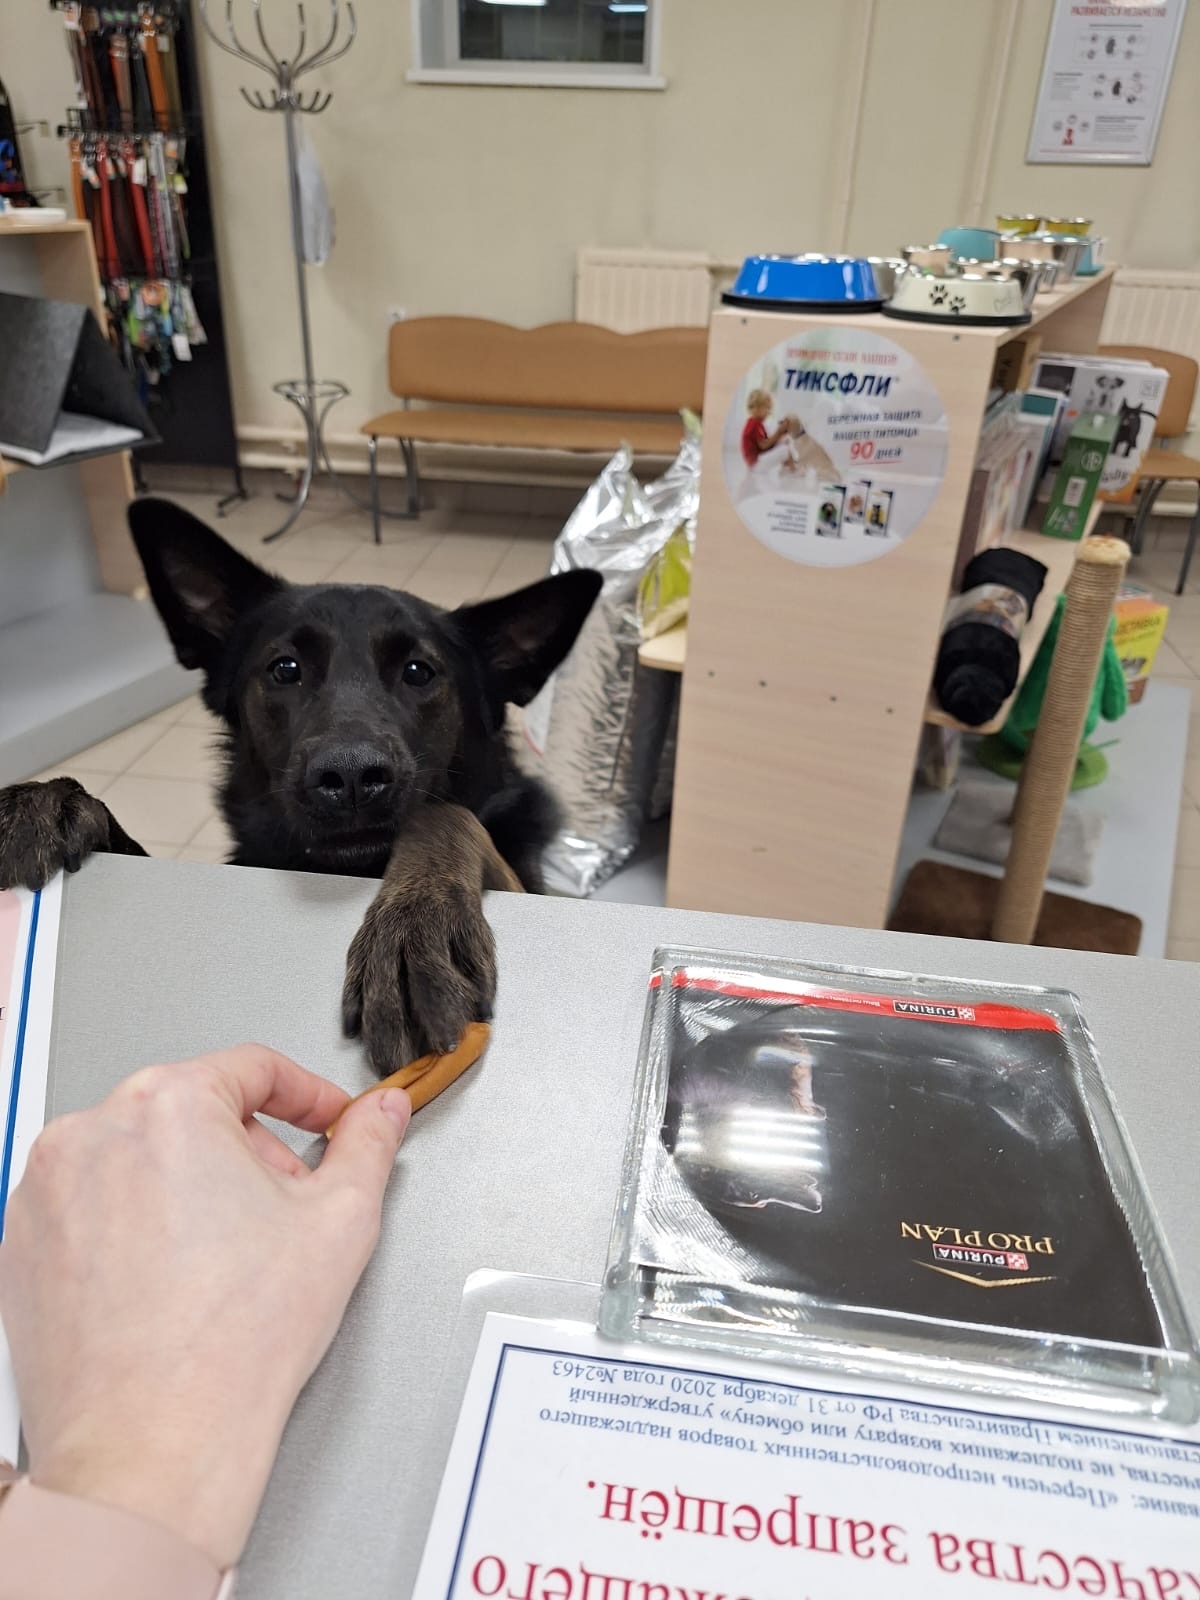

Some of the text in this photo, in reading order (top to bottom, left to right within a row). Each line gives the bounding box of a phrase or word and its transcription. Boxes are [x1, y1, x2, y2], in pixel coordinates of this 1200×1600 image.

[784, 368, 892, 397] ТИКСФЛИ
[883, 410, 922, 423] ЗАЩИТА
[850, 441, 902, 460] 90 ДНЕЙ
[898, 1002, 956, 1017] PURINA
[901, 1222, 1055, 1255] PRO PLAN
[938, 1247, 1005, 1265] PURINA
[553, 1361, 618, 1383] №2463
[624, 1369, 664, 1385] года
[671, 1377, 716, 1397] 2020
[722, 1383, 800, 1405] декабря
[569, 1388, 713, 1418] утвержденный
[807, 1392, 829, 1415] 31
[835, 1396, 855, 1412] от
[863, 1405, 893, 1422] РФ
[540, 1409, 671, 1438] надлежащего
[720, 1409, 804, 1435] обмену»
[811, 1423, 846, 1437] или
[900, 1409, 1052, 1442] Правительства
[678, 1429, 757, 1452] товаров
[855, 1426, 942, 1451] возврату
[765, 1442, 995, 1482] непродовольственных
[950, 1442, 1083, 1471] подлежащих
[1091, 1462, 1114, 1476] не
[1003, 1476, 1117, 1507] «Перечень
[587, 1480, 908, 1563] запрещён.
